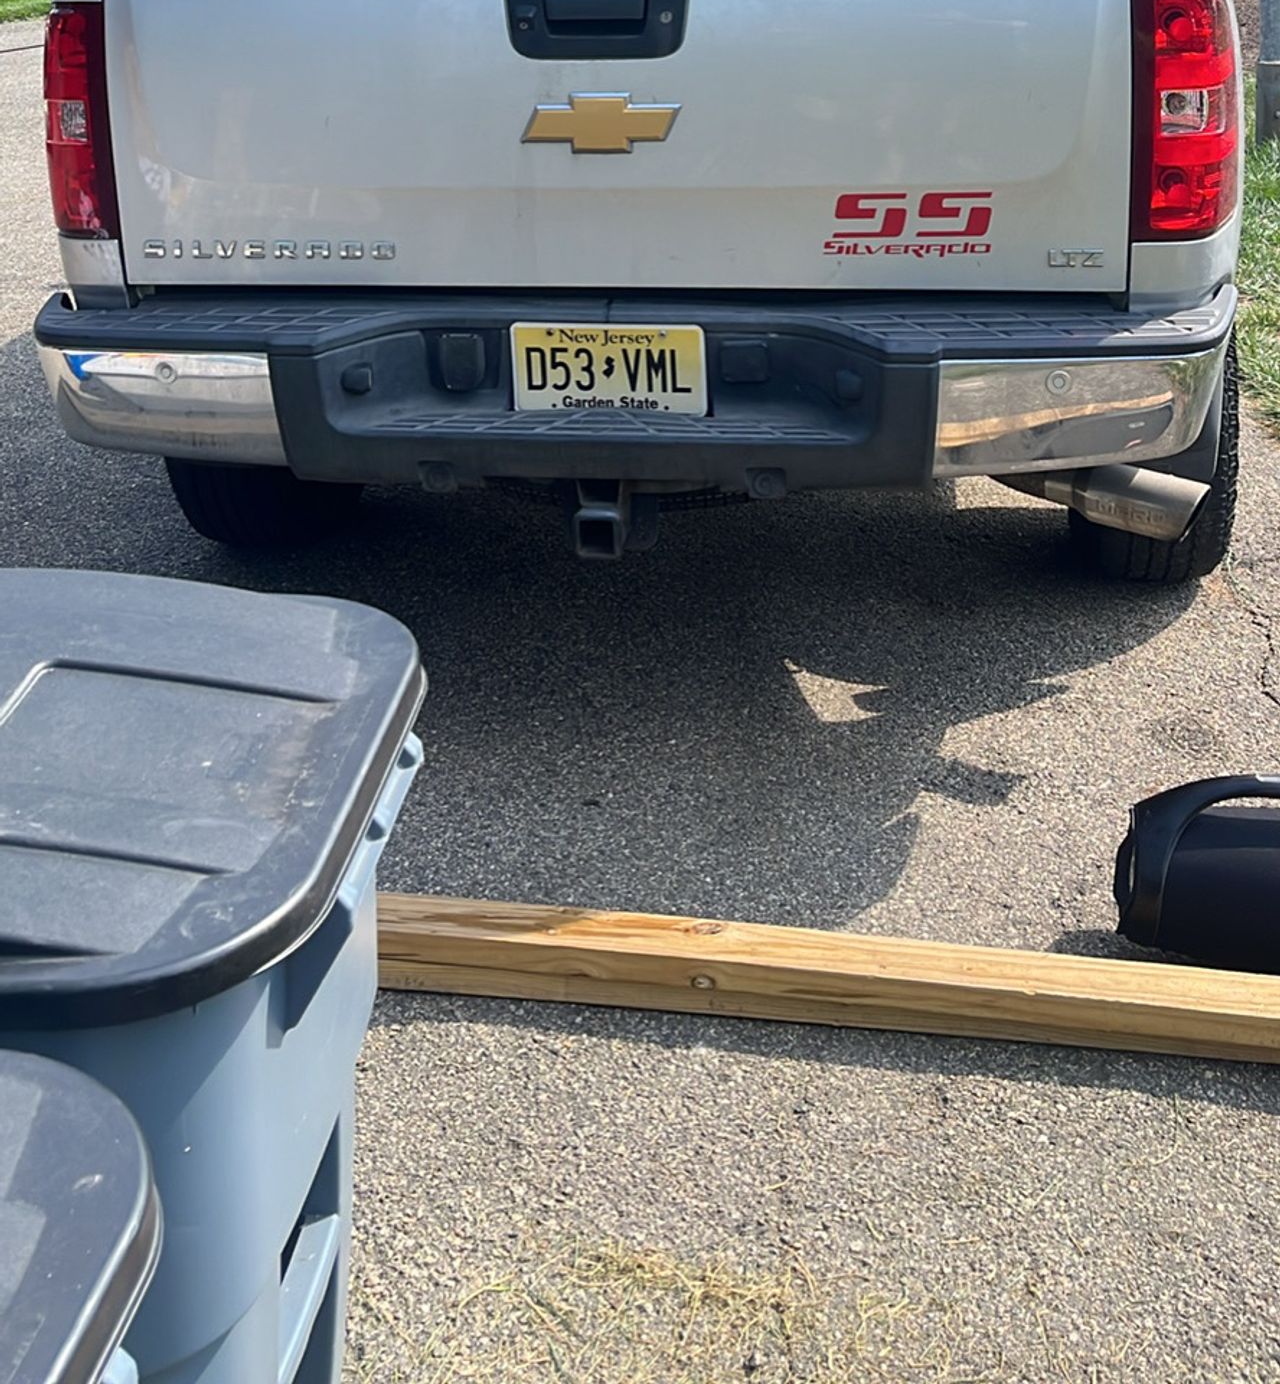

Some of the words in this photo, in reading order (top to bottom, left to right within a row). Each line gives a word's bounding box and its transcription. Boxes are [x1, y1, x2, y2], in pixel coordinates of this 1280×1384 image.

[832, 192, 992, 238] SS
[144, 240, 396, 259] SILVERADO
[1048, 249, 1104, 267] LTZ
[559, 329, 599, 343] New
[602, 330, 655, 346] Jersey
[525, 347, 595, 391] D53
[622, 348, 692, 393] VML
[562, 395, 614, 409] Garden
[620, 396, 659, 409] State
